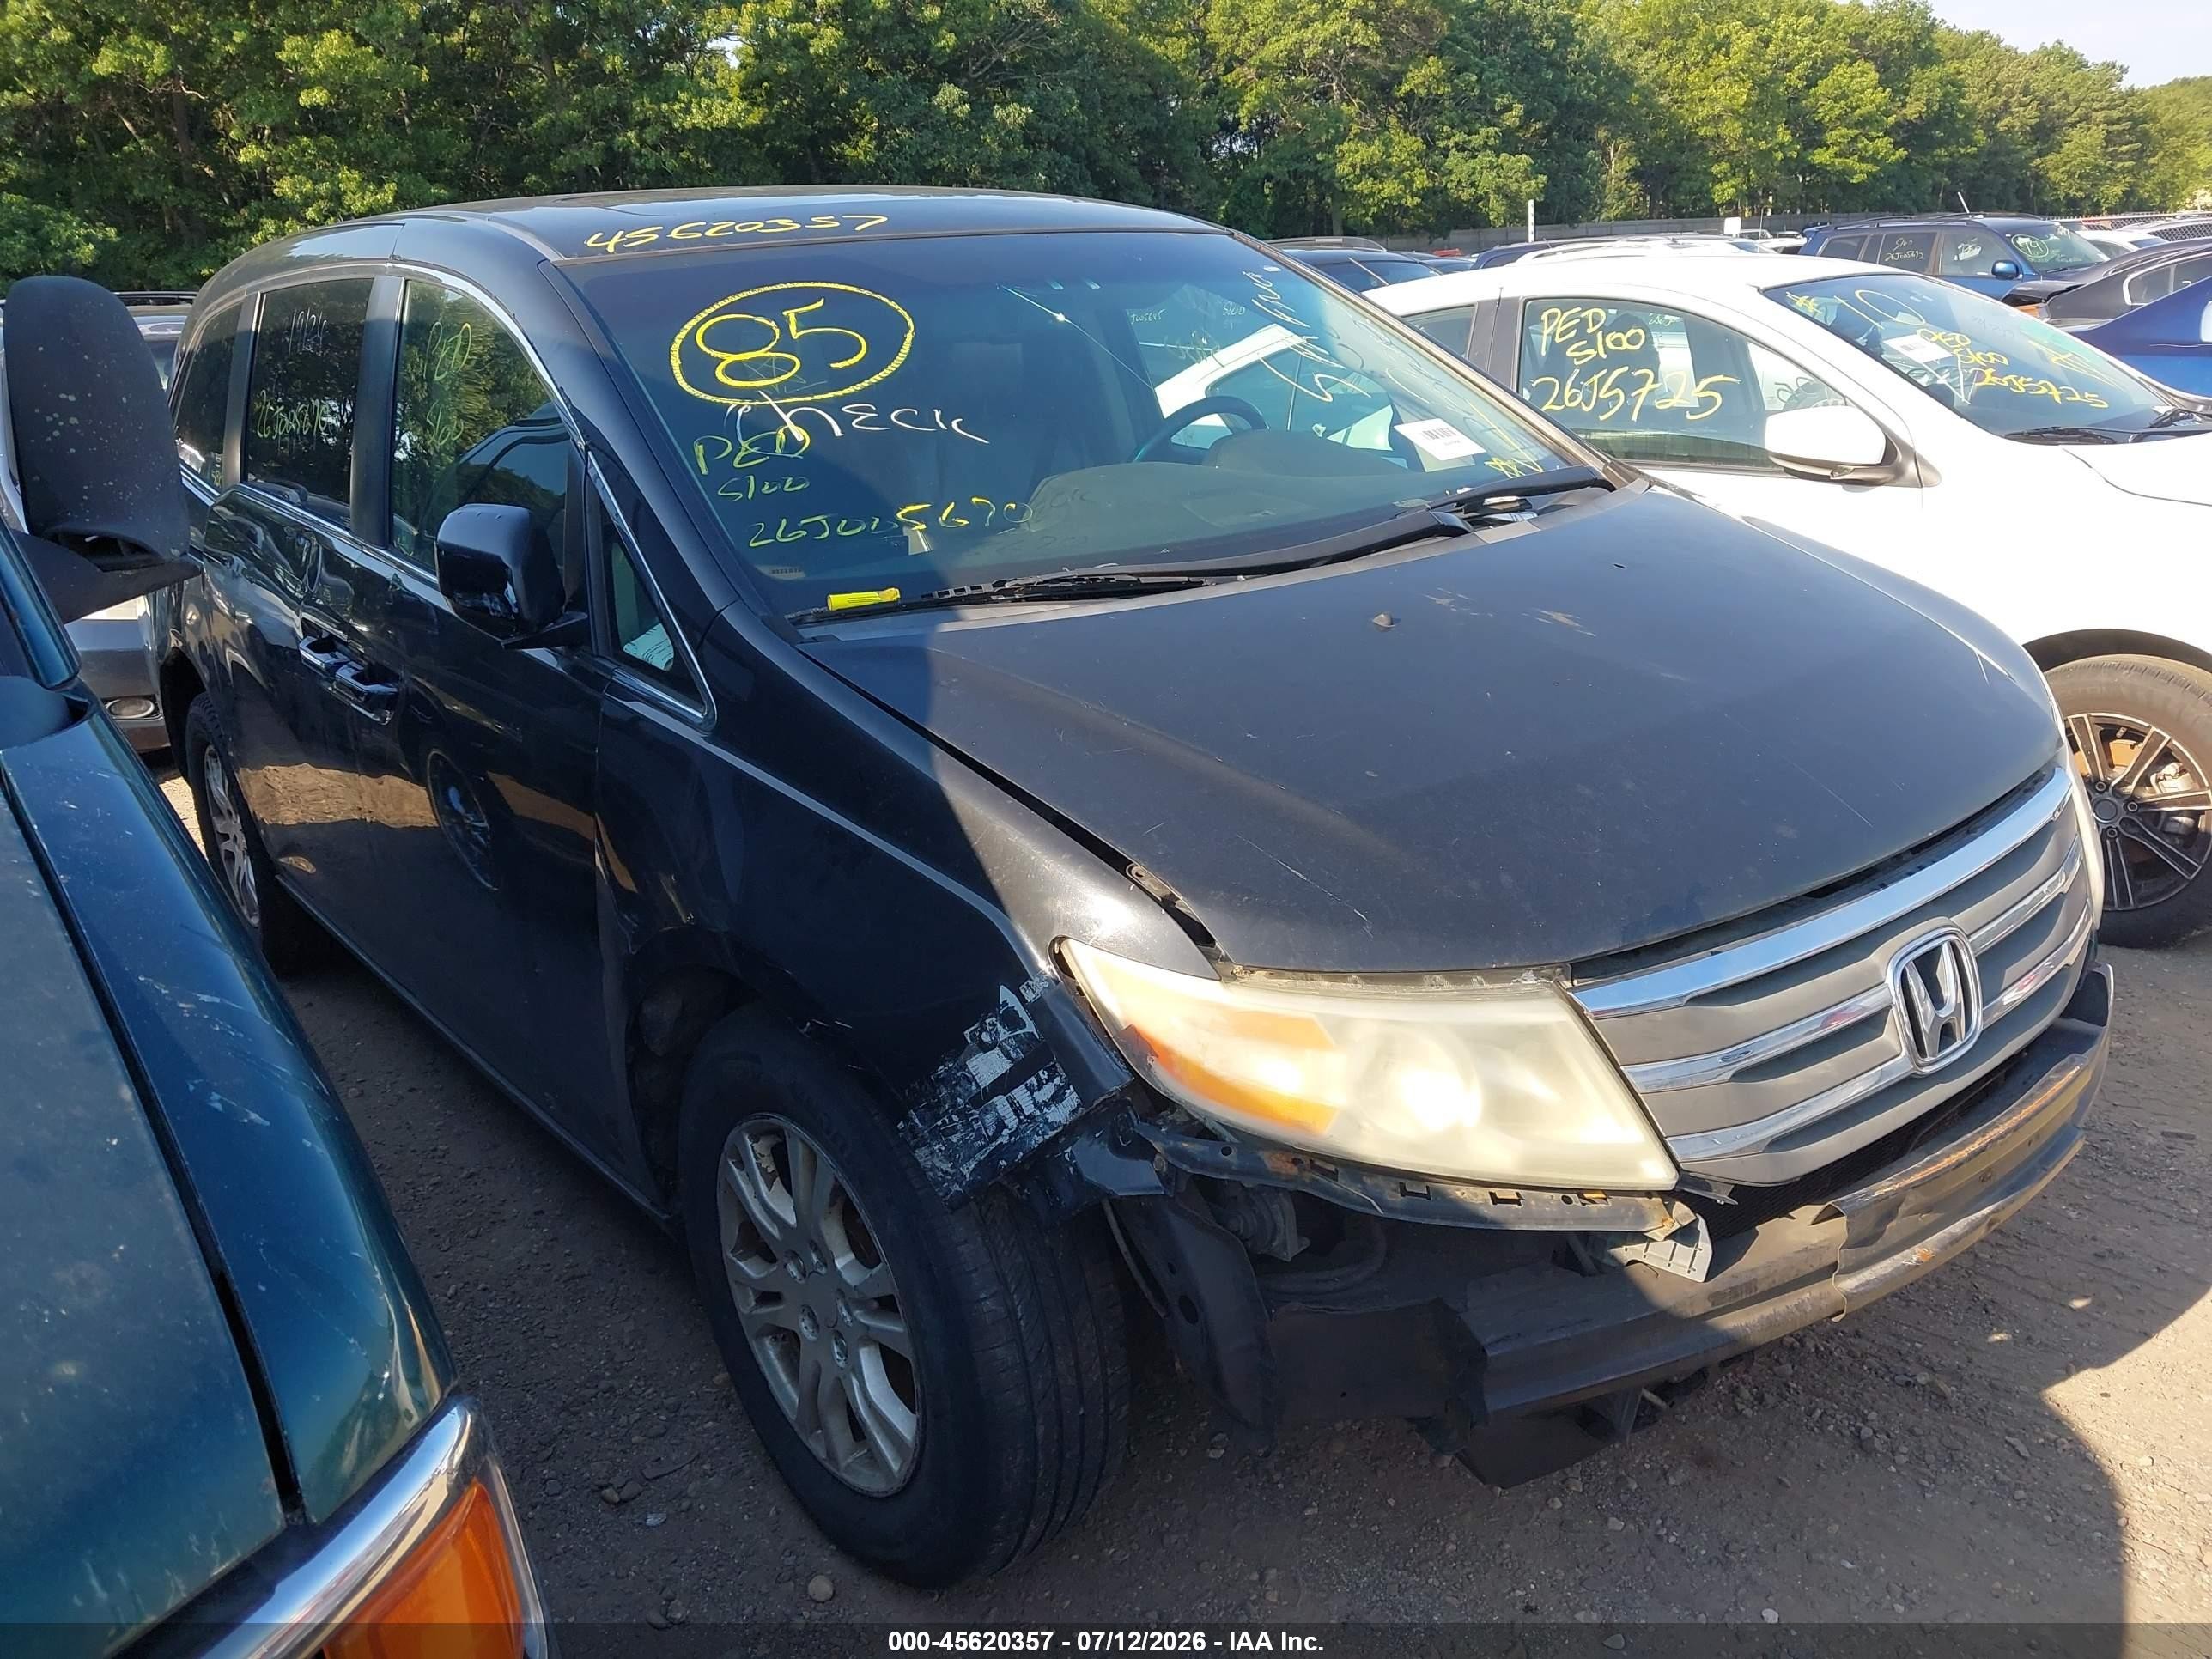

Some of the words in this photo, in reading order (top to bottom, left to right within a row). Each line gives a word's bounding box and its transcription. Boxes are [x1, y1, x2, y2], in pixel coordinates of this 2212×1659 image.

[584, 214, 890, 254] 45620357
[695, 298, 868, 388] 85
[1540, 306, 1607, 356] PED
[1565, 327, 1646, 365] S100
[1531, 366, 1742, 422] 26J5725
